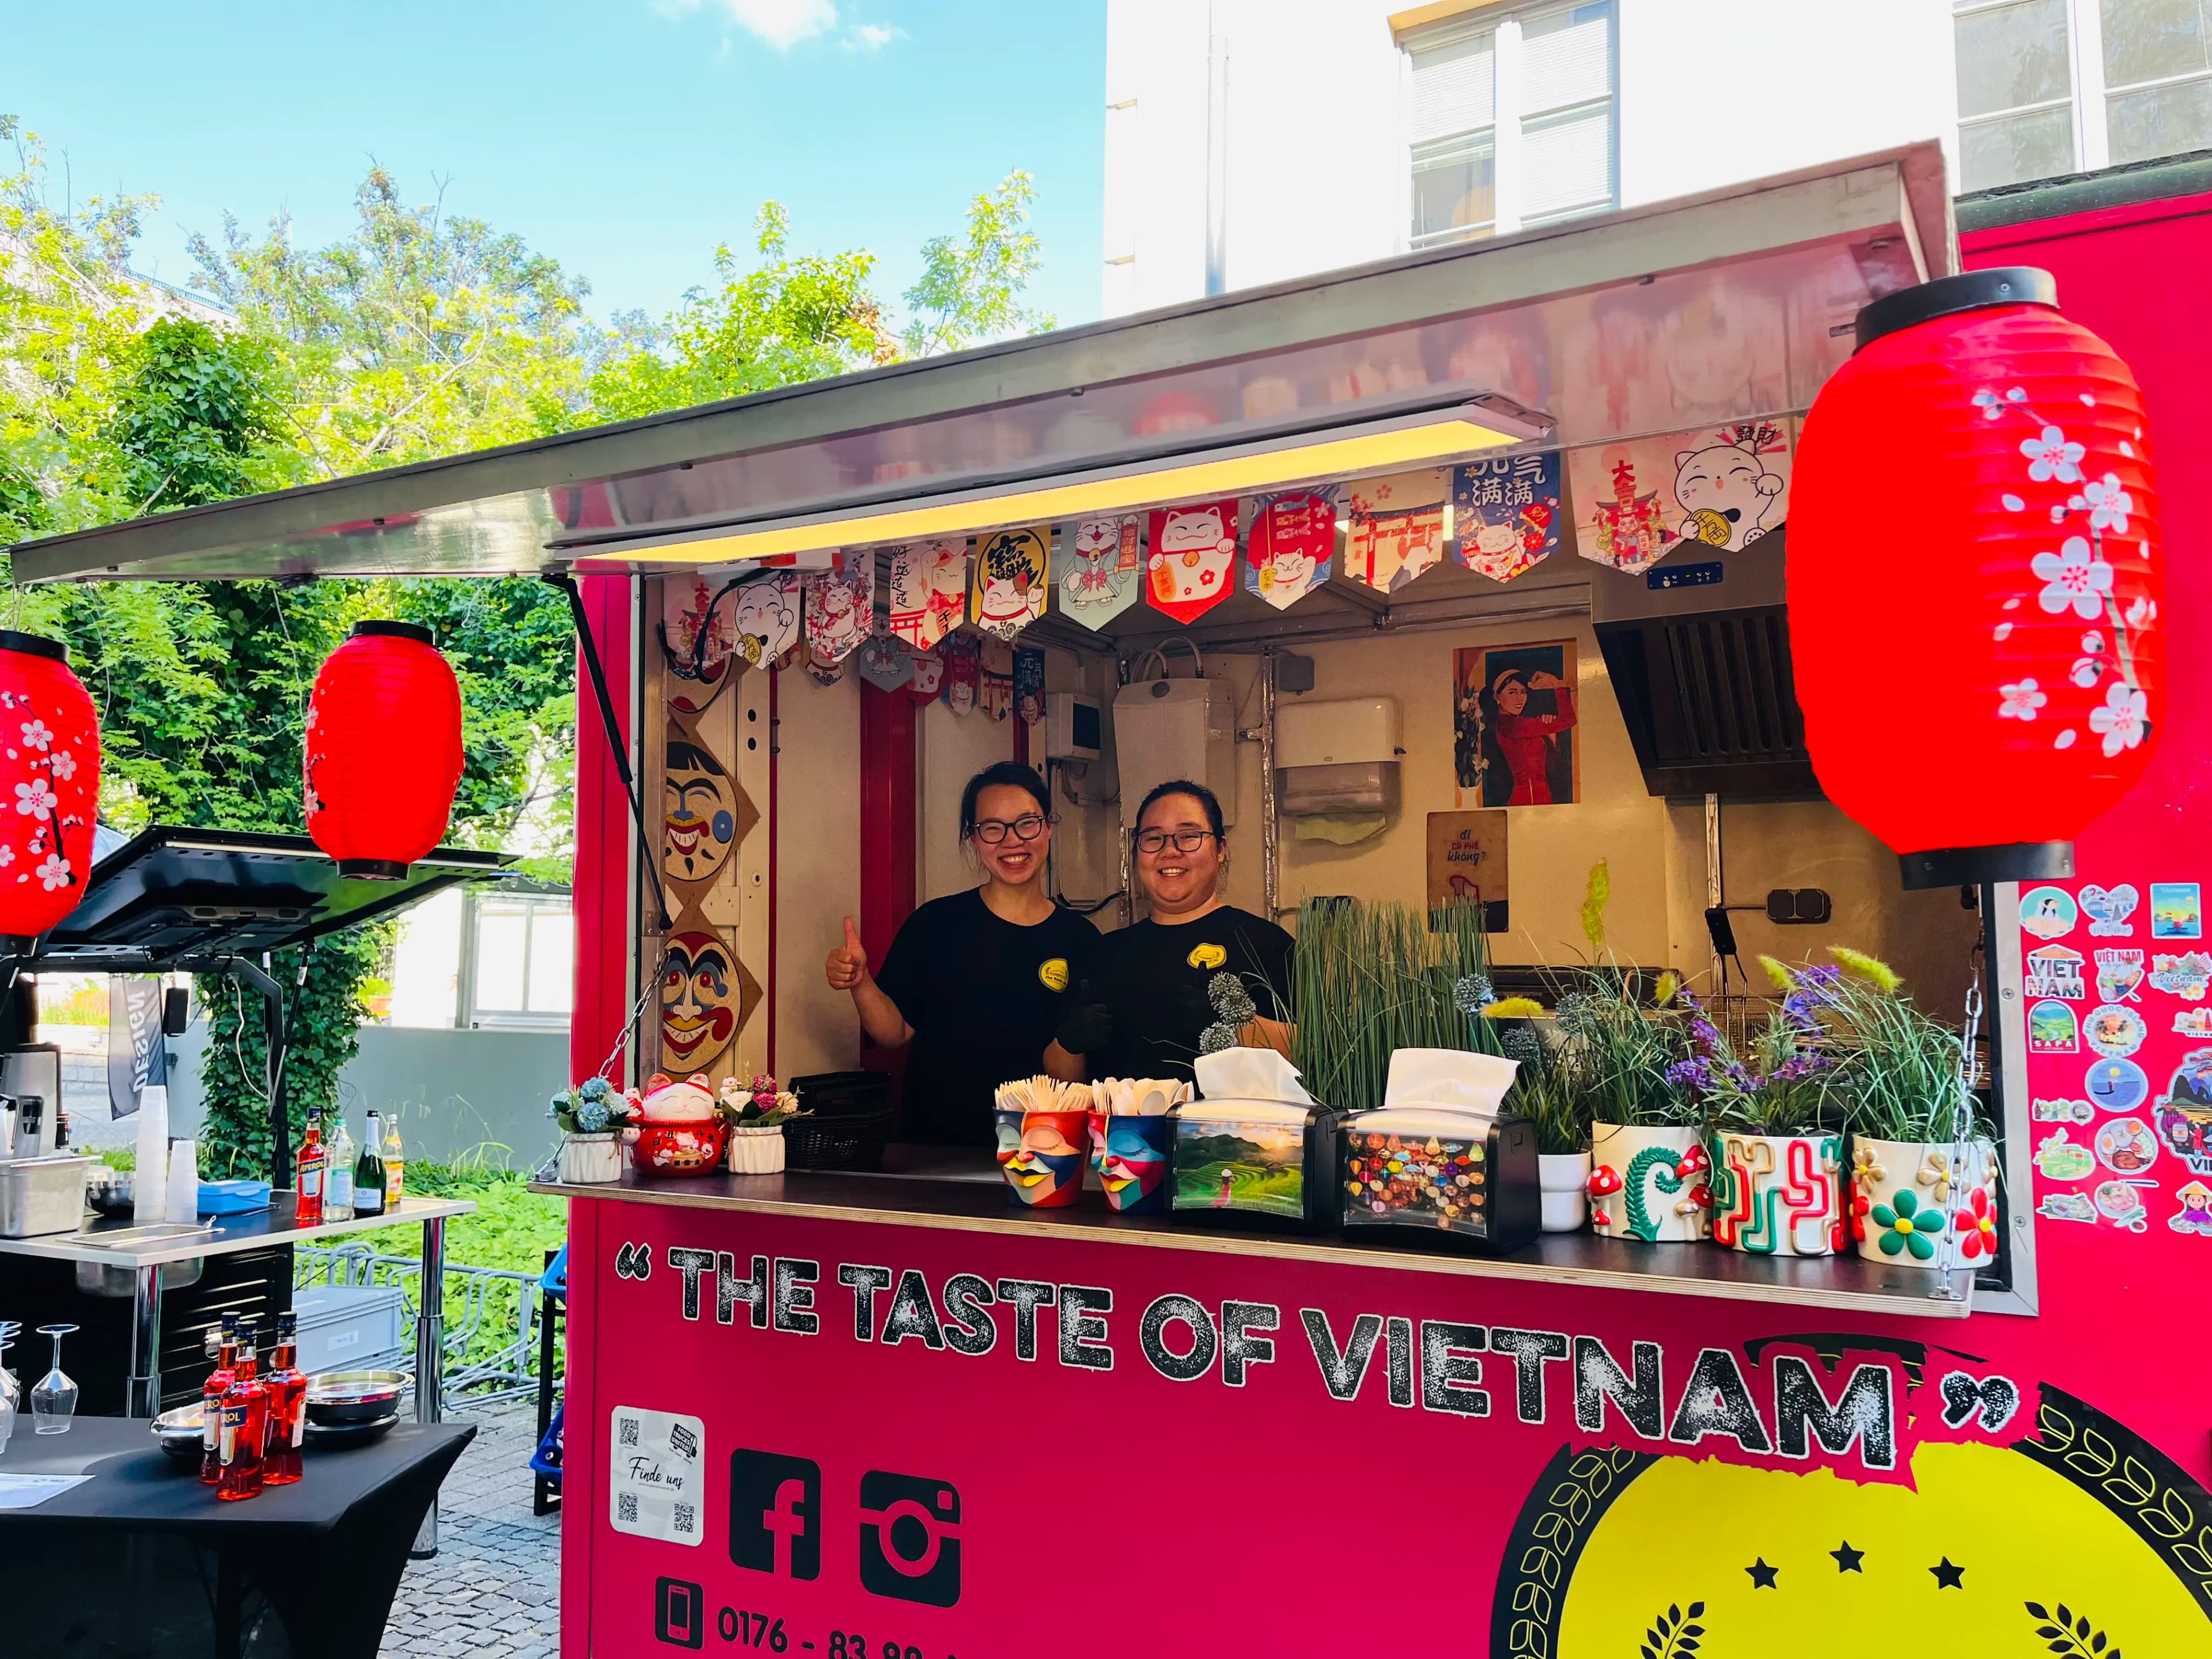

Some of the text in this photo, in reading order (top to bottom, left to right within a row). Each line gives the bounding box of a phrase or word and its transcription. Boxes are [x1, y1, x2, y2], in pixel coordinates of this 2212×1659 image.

[1472, 477, 1533, 507] 满满
[2029, 960, 2083, 978] VIET
[2157, 972, 2203, 983] Vietnam
[2028, 978, 2082, 998] NAM
[667, 1246, 820, 1336] THE
[838, 1263, 1114, 1372] TASTE
[1139, 1293, 1281, 1388] OF
[1299, 1307, 1896, 1471] VIETNAM
[673, 1430, 690, 1445] TRUCKS
[677, 1426, 691, 1438] FOOD
[671, 1437, 689, 1451] UNITED
[628, 1456, 662, 1482] Finde
[666, 1475, 684, 1490] uns
[718, 1606, 789, 1654] 0176
